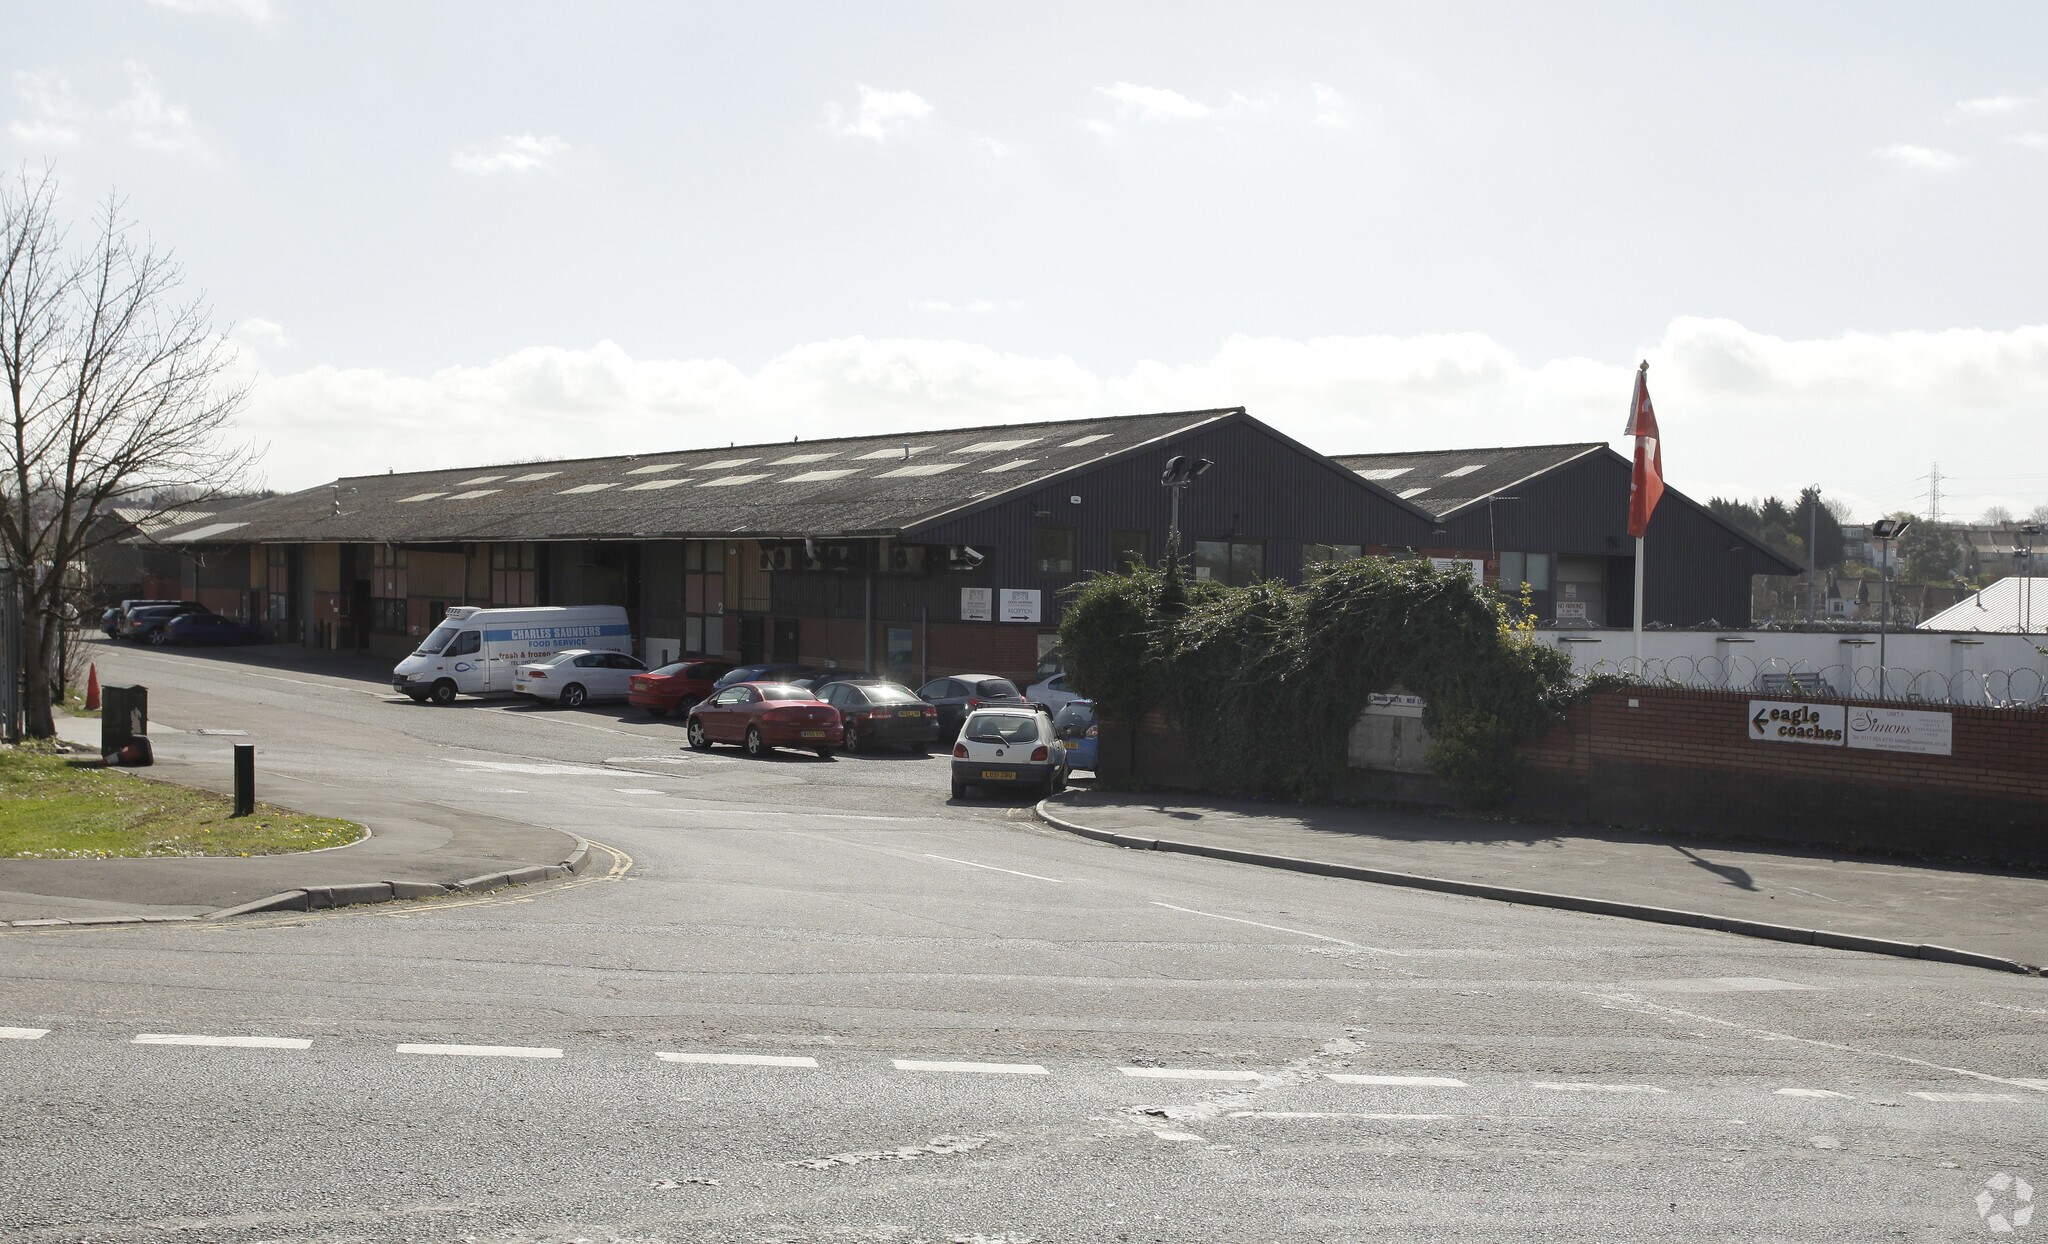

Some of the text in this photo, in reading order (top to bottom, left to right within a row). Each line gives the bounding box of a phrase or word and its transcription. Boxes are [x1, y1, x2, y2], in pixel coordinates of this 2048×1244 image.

[718, 602, 724, 615] 2
[1565, 602, 1584, 610] PARKING
[511, 626, 601, 640] CHARLES SAUNDERS
[528, 638, 587, 648] FOOD SERVICE
[499, 652, 519, 660] fresh
[521, 651, 526, 659] &
[528, 650, 551, 658] frozen
[1769, 704, 1820, 727] eagle
[1850, 709, 1912, 735] Simons
[1777, 724, 1842, 741] coaches
